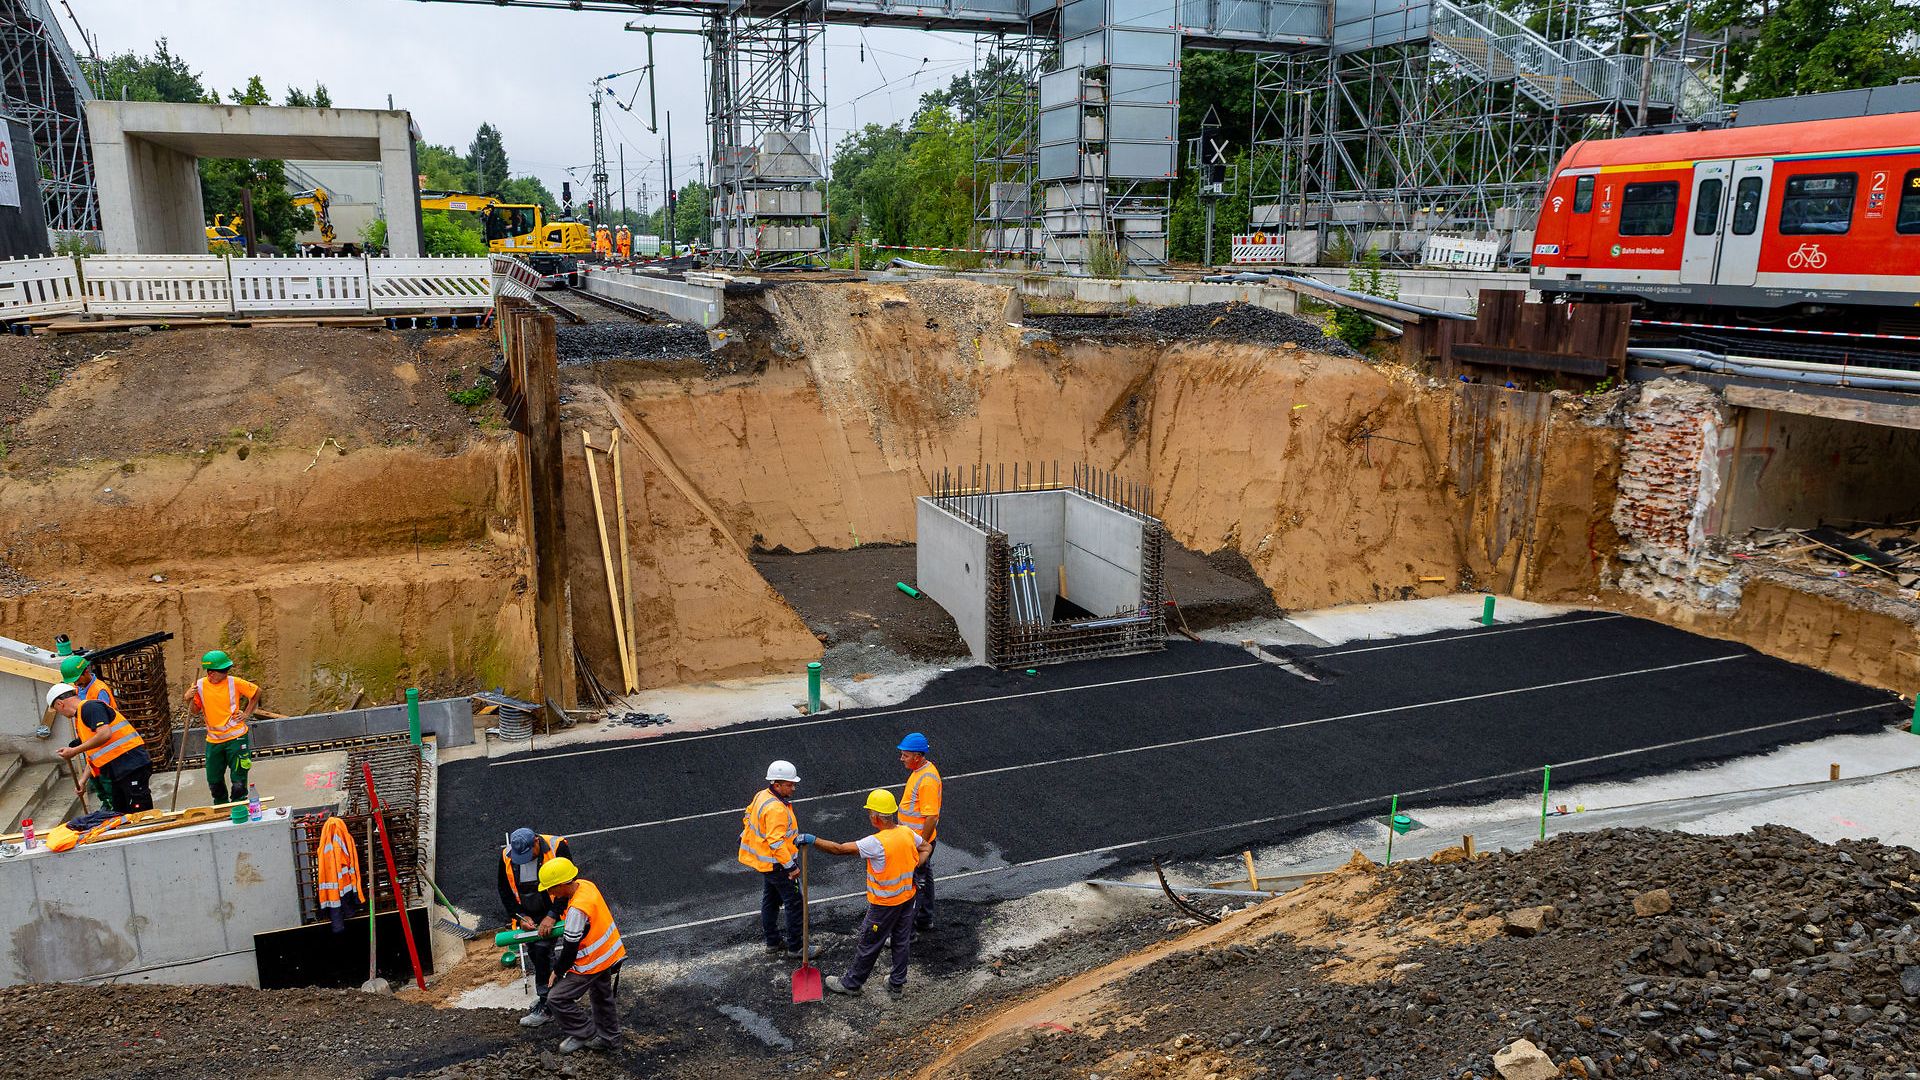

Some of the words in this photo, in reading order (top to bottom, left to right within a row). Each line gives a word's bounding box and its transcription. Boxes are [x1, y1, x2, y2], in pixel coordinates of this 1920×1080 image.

[1872, 173, 1886, 191] 2
[1604, 185, 1611, 201] 1
[1612, 245, 1620, 256] S
